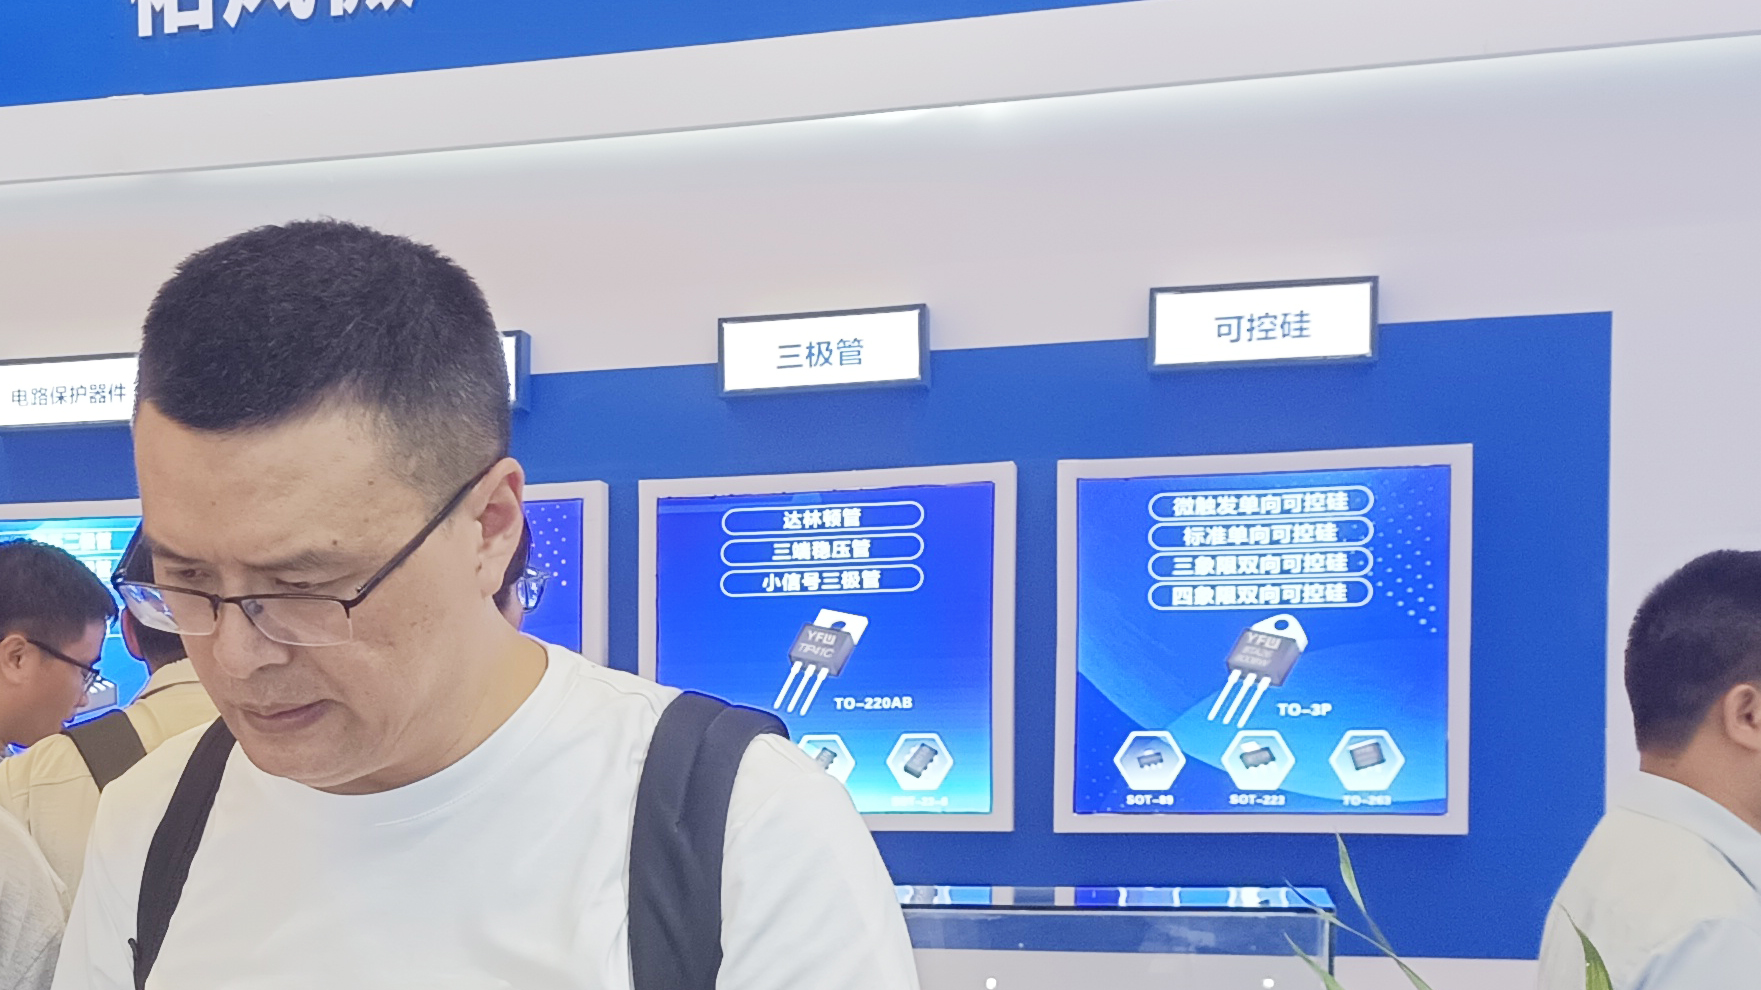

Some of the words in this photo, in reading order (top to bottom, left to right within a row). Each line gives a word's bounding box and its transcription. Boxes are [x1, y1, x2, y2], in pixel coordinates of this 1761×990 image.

[1214, 311, 1312, 343] 可控硅
[776, 337, 865, 370] 三极管
[11, 382, 127, 407] 电路保护器件
[1172, 491, 1350, 517] 微触发单向可控硅
[782, 507, 863, 530] 达林顿管
[1182, 521, 1339, 547] 标准单向可控硅
[771, 538, 872, 561] 三端稳压管
[1171, 551, 1349, 577] 三象限双向可控硅
[762, 570, 882, 593] 小信号三极管
[1171, 581, 1349, 607] 四象限双向可控硅
[833, 696, 914, 710] TO-220AB
[1276, 702, 1333, 717] TO-3P
